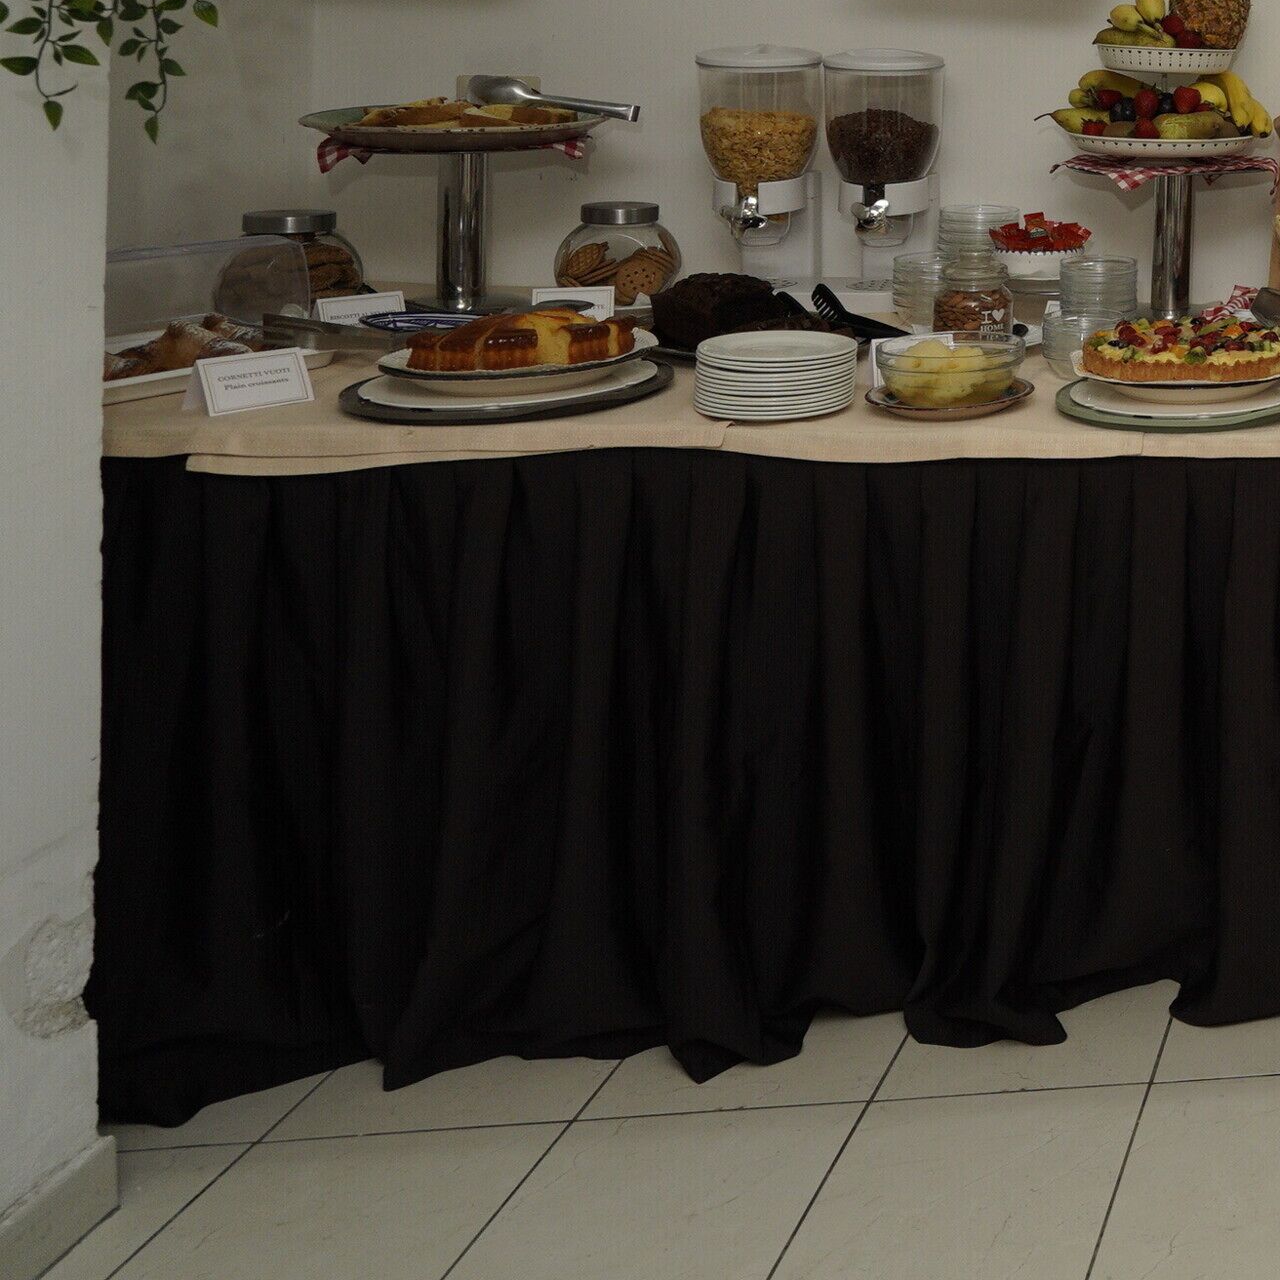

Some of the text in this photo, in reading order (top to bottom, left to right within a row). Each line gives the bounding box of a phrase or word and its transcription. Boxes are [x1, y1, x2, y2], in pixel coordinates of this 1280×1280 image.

[217, 371, 263, 383] CORNETTI
[224, 376, 289, 391] Plain croissants
